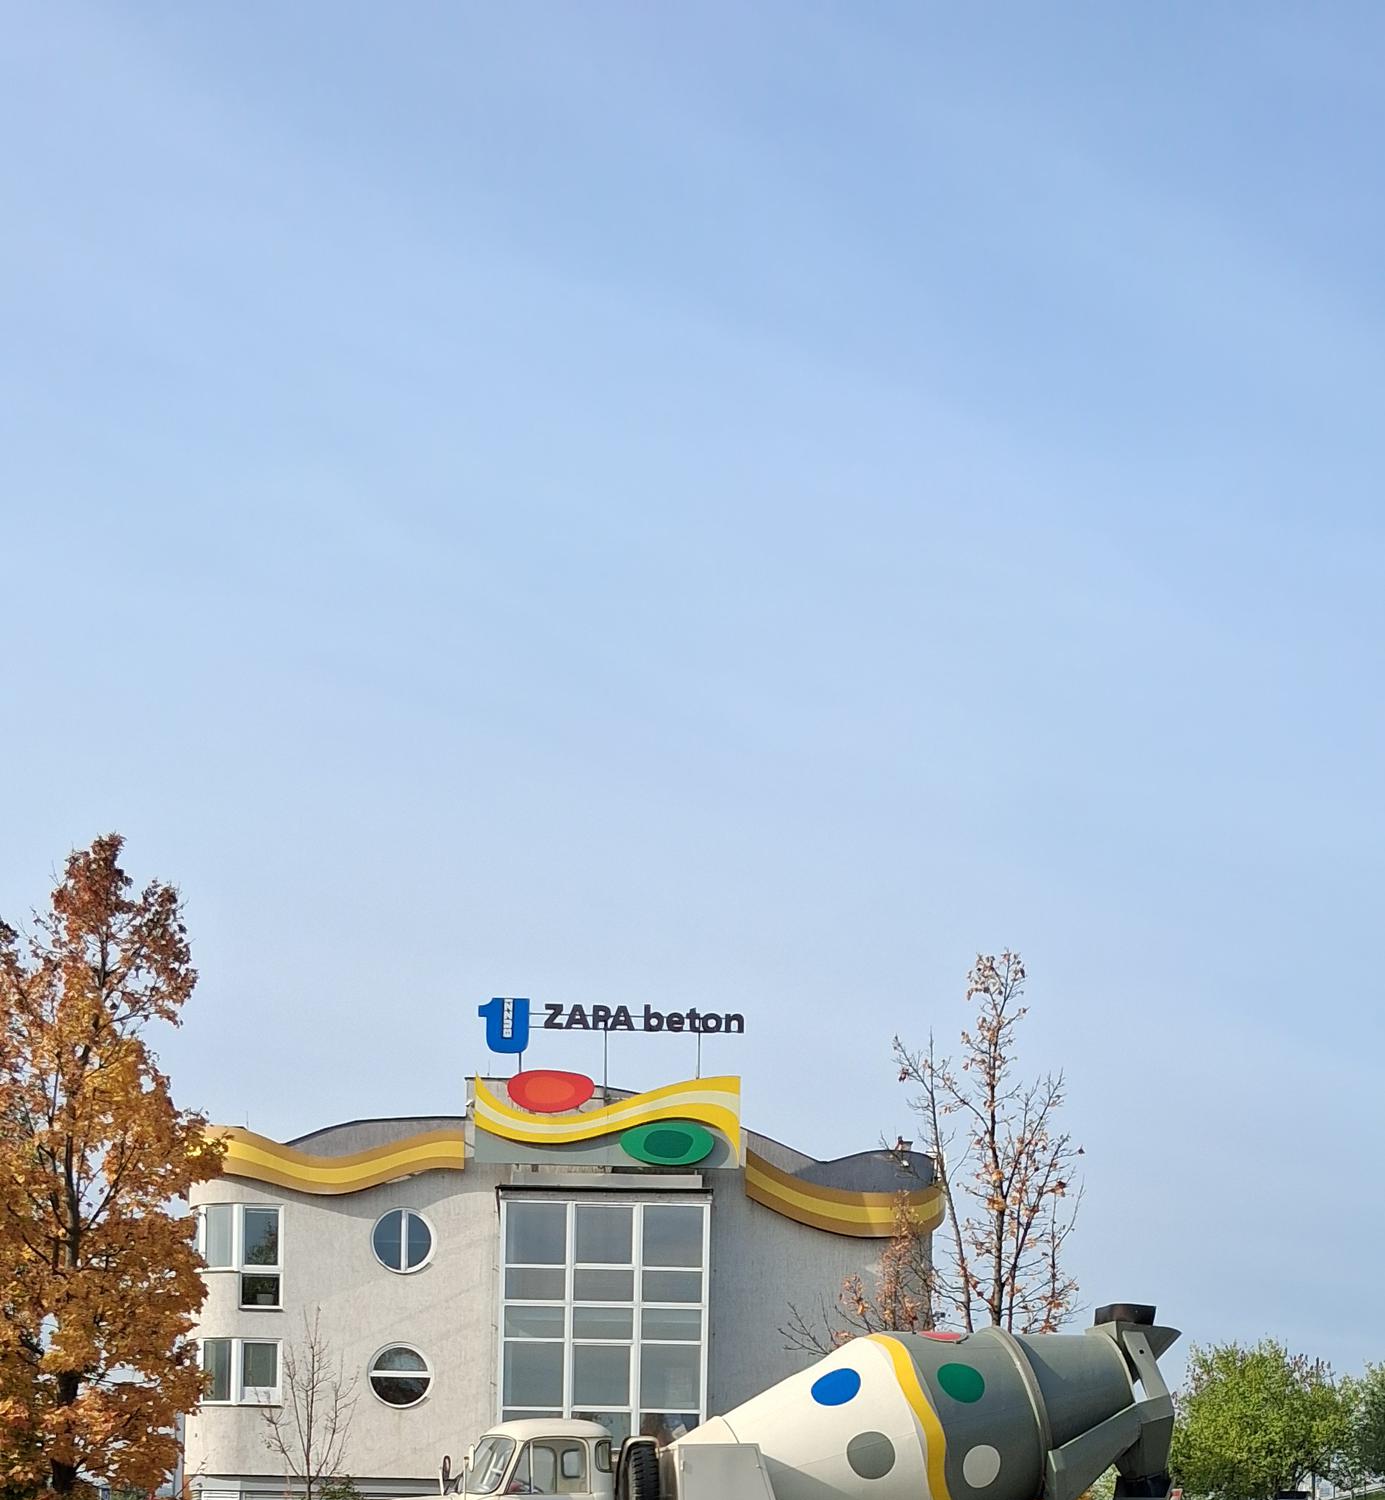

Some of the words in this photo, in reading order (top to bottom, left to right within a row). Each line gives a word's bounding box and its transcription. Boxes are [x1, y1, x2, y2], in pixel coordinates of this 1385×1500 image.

[503, 998, 513, 1038] BUZZI
[544, 1003, 633, 1030] ZAPA
[644, 1004, 744, 1033] beton
